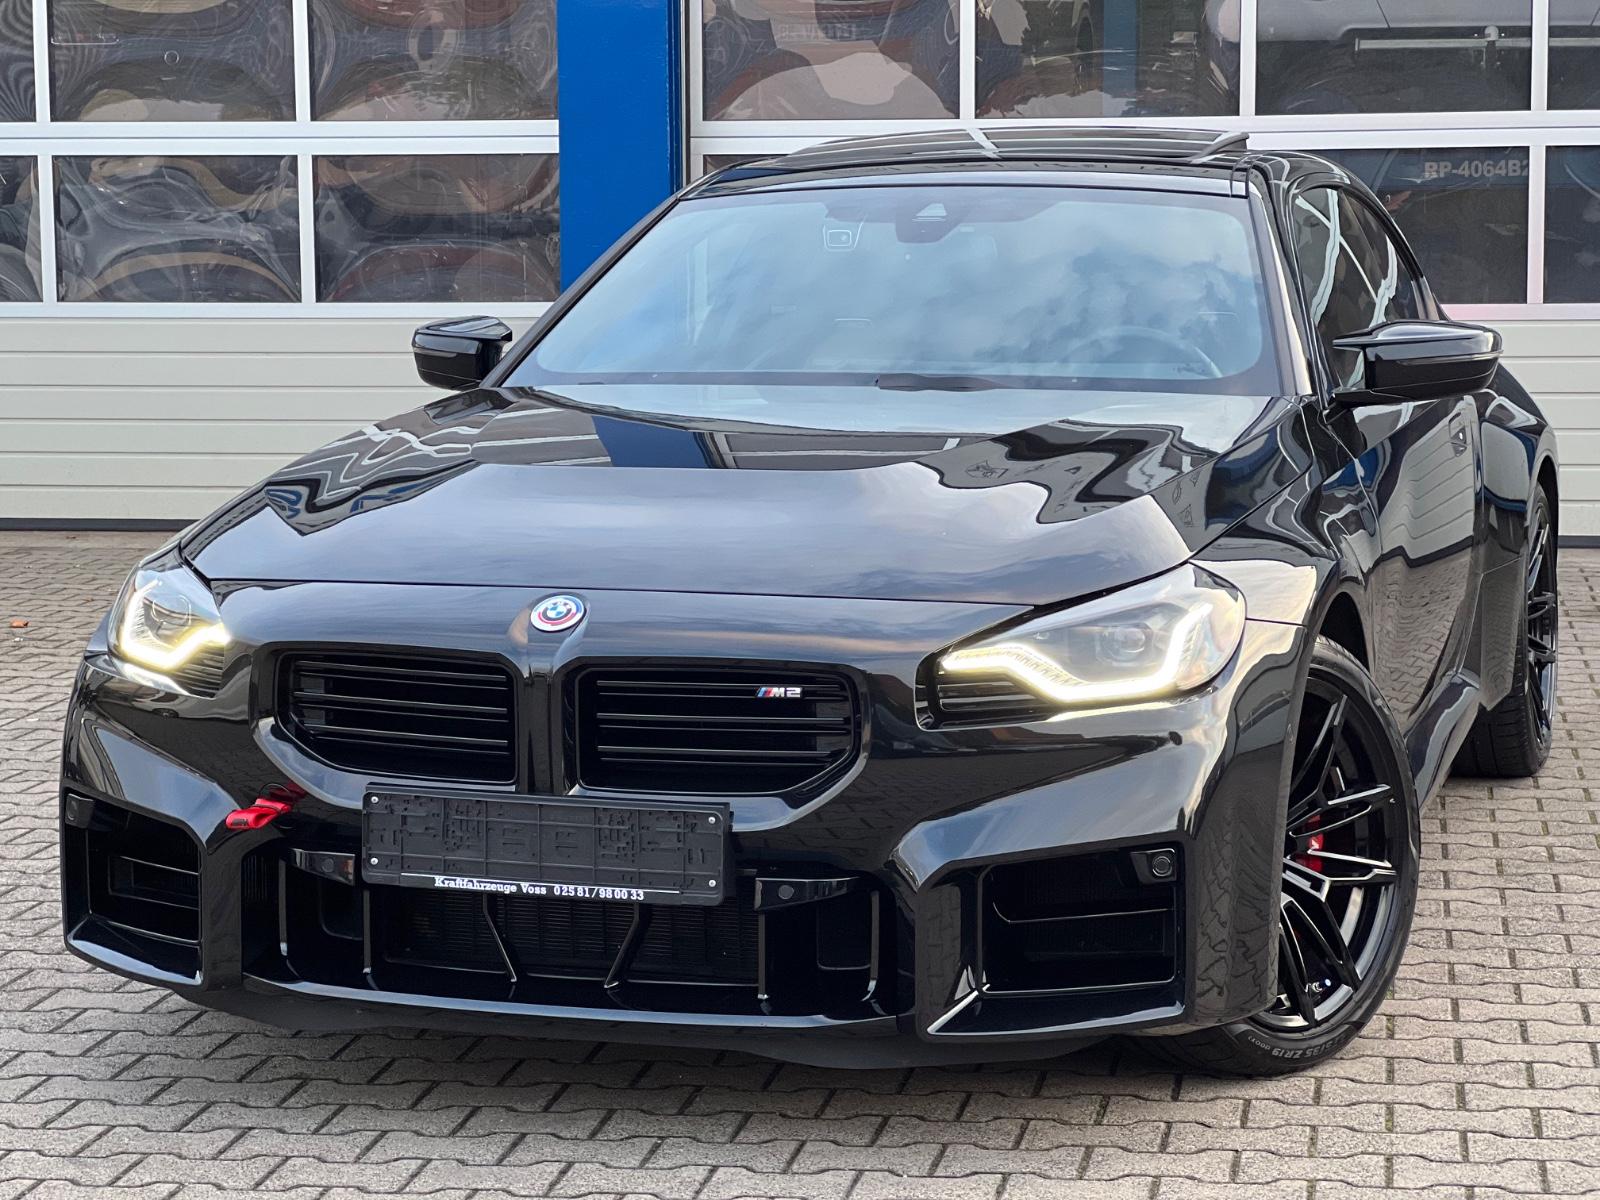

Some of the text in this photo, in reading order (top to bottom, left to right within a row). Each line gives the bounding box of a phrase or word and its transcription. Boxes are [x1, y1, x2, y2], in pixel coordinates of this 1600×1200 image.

[434, 876, 517, 894] Kraftfahrzeuge
[520, 882, 547, 894] Voss
[1272, 1047, 1304, 1059] ZR19
